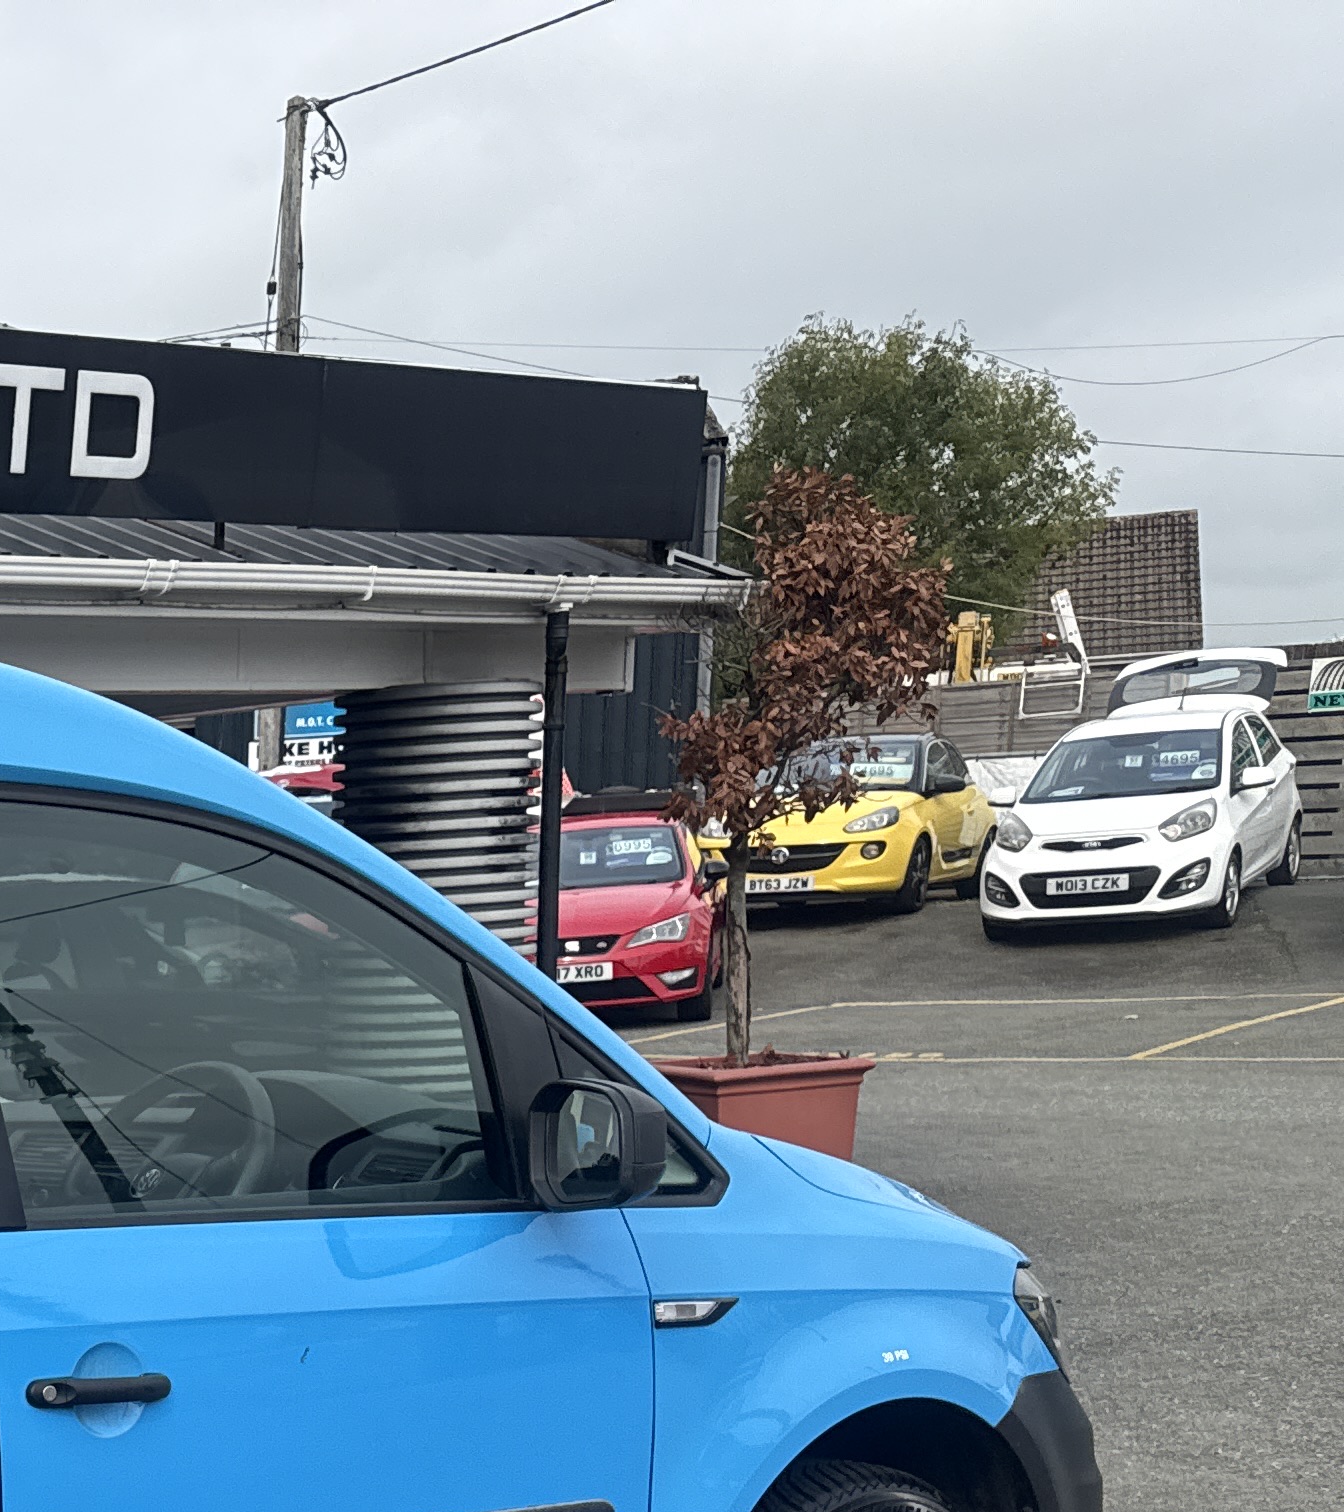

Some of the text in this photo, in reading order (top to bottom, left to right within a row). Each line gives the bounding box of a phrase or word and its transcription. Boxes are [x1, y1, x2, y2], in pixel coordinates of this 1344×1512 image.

[1314, 694, 1344, 707] NE
[749, 878, 781, 891] BT63
[1091, 877, 1121, 890] CZK
[574, 964, 604, 979] XRO
